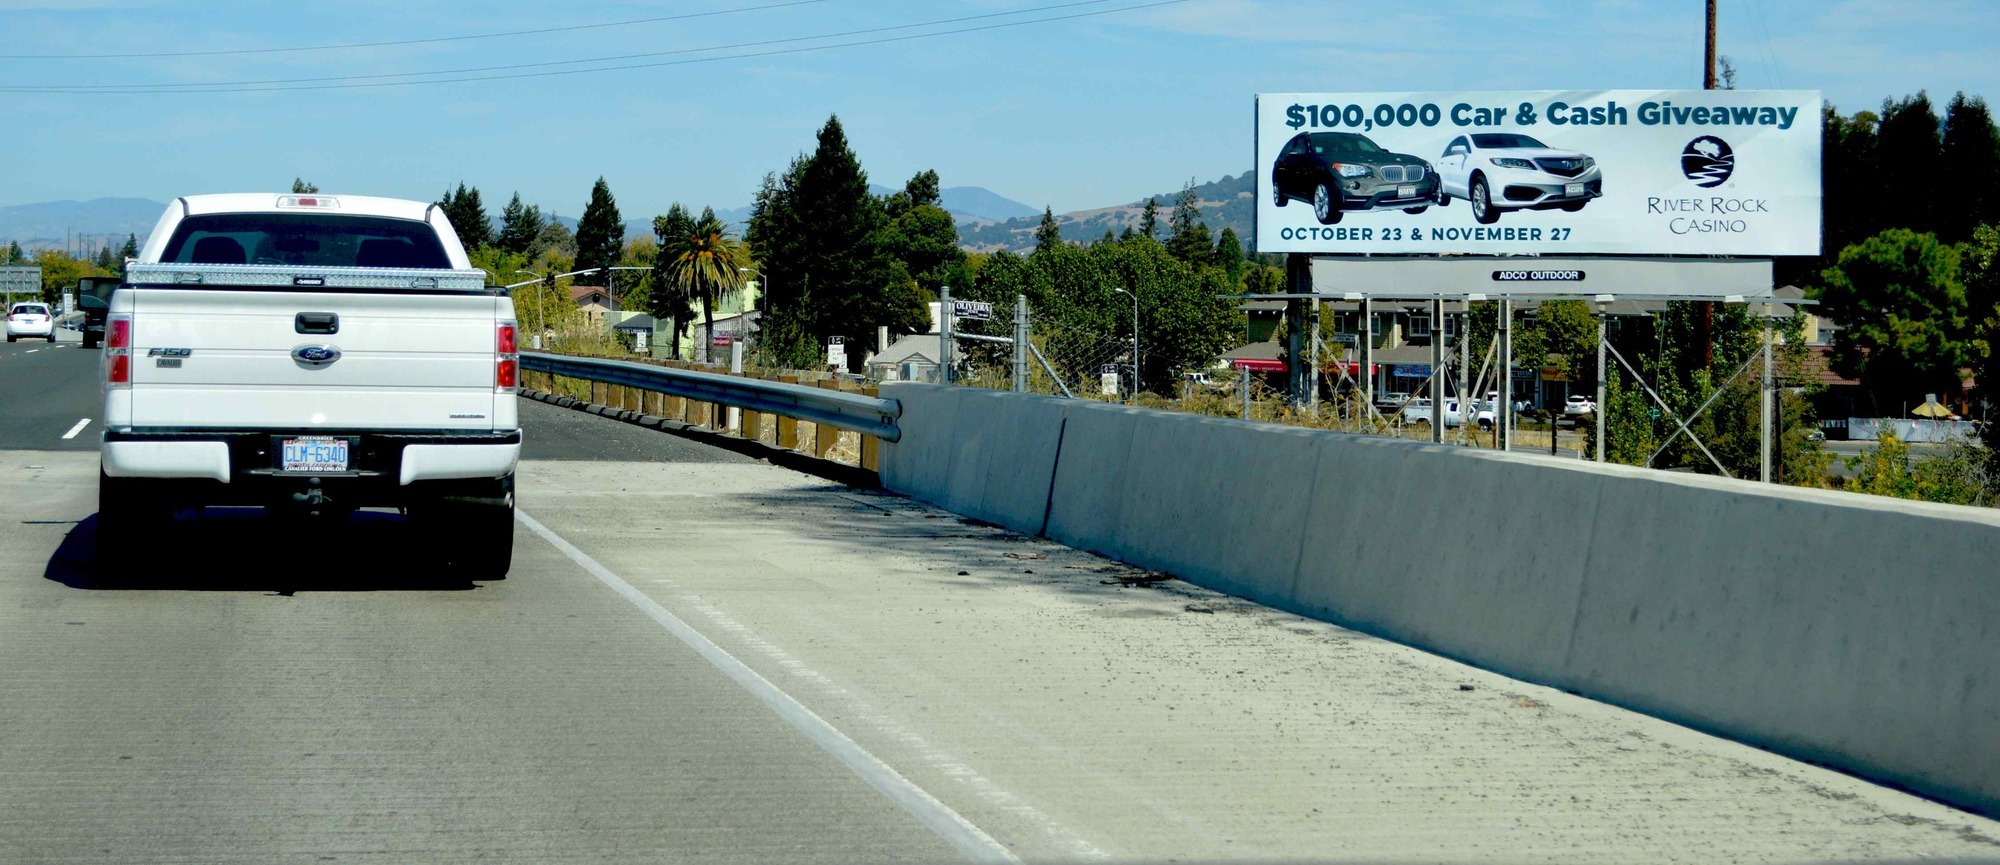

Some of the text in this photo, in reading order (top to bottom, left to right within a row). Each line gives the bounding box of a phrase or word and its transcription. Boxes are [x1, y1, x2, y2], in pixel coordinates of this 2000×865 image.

[1285, 101, 1799, 132] $100,000 Car & Cash Giveaway
[1398, 188, 1416, 196] BMW
[1647, 196, 1769, 214] RIVER ROCK
[1669, 217, 1747, 235] CASINO
[1280, 227, 1571, 241] OCTOBER 23 & NOVEMBER 27
[1499, 271, 1579, 280] ADCO OUTDOOR
[956, 302, 989, 312] OLIVEIRA
[147, 348, 192, 357] F-150
[305, 349, 328, 359] Ford
[157, 359, 182, 367] CAVALIER
[285, 446, 346, 462] CLM-6340
